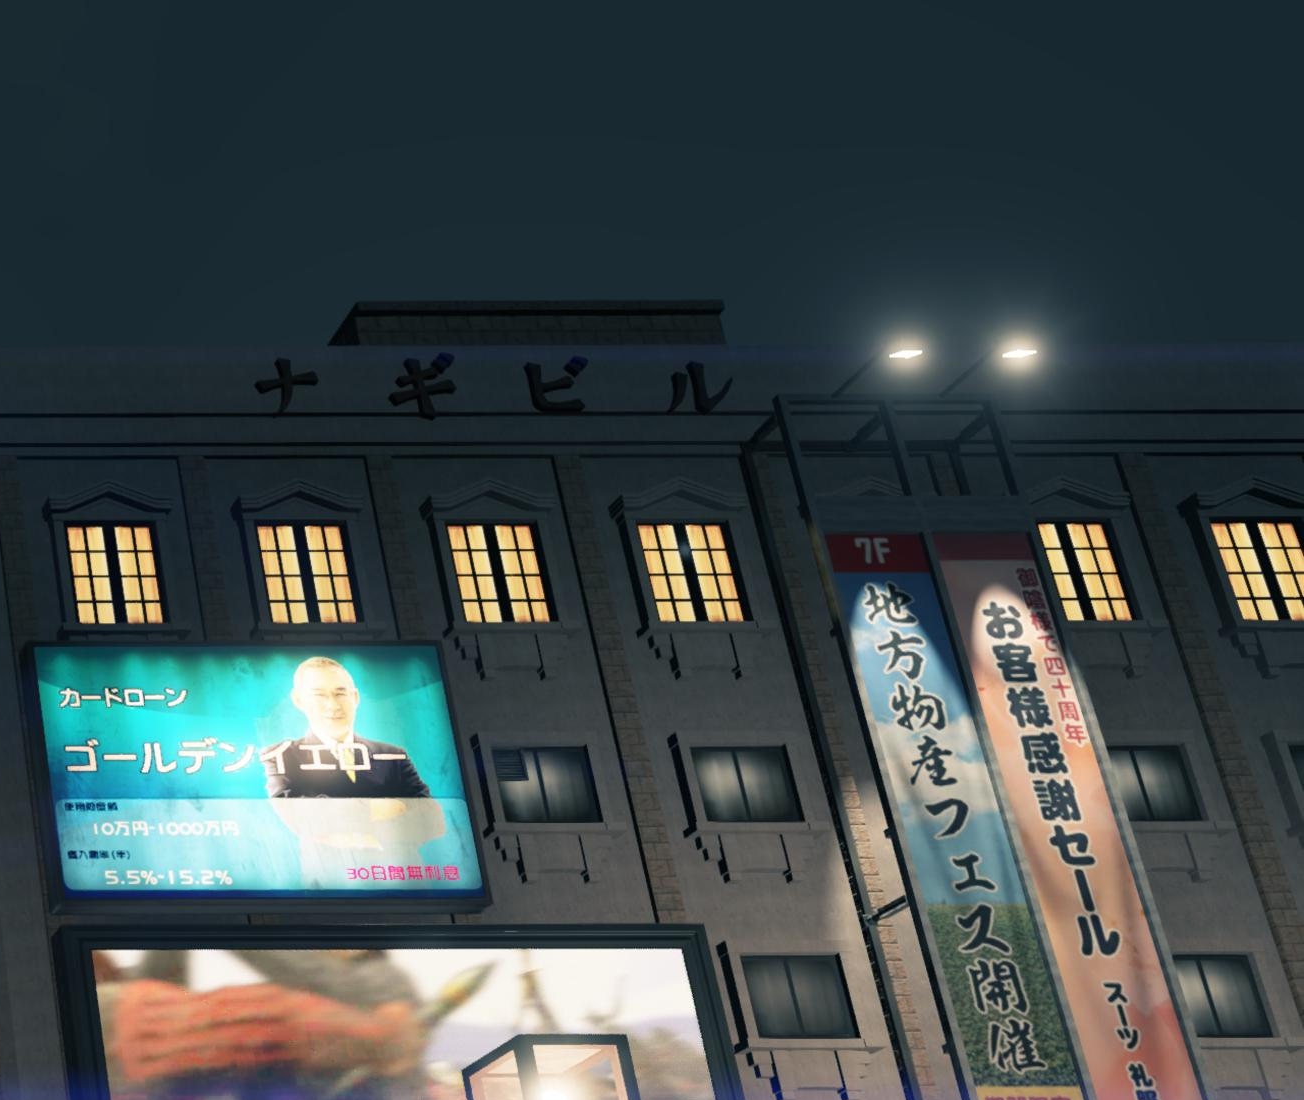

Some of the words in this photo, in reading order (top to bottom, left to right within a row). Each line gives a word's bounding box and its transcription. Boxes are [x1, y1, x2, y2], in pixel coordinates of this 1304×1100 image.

[255, 352, 733, 420] ナギビル
[855, 537, 891, 565] 7F
[58, 687, 189, 708] カードローン
[63, 736, 408, 775] ゴールデンイエロー
[982, 600, 1121, 958] お客様感謝セール
[863, 582, 1047, 1074] 地方物産フェス開催
[1103, 981, 1139, 1051] スーツ
